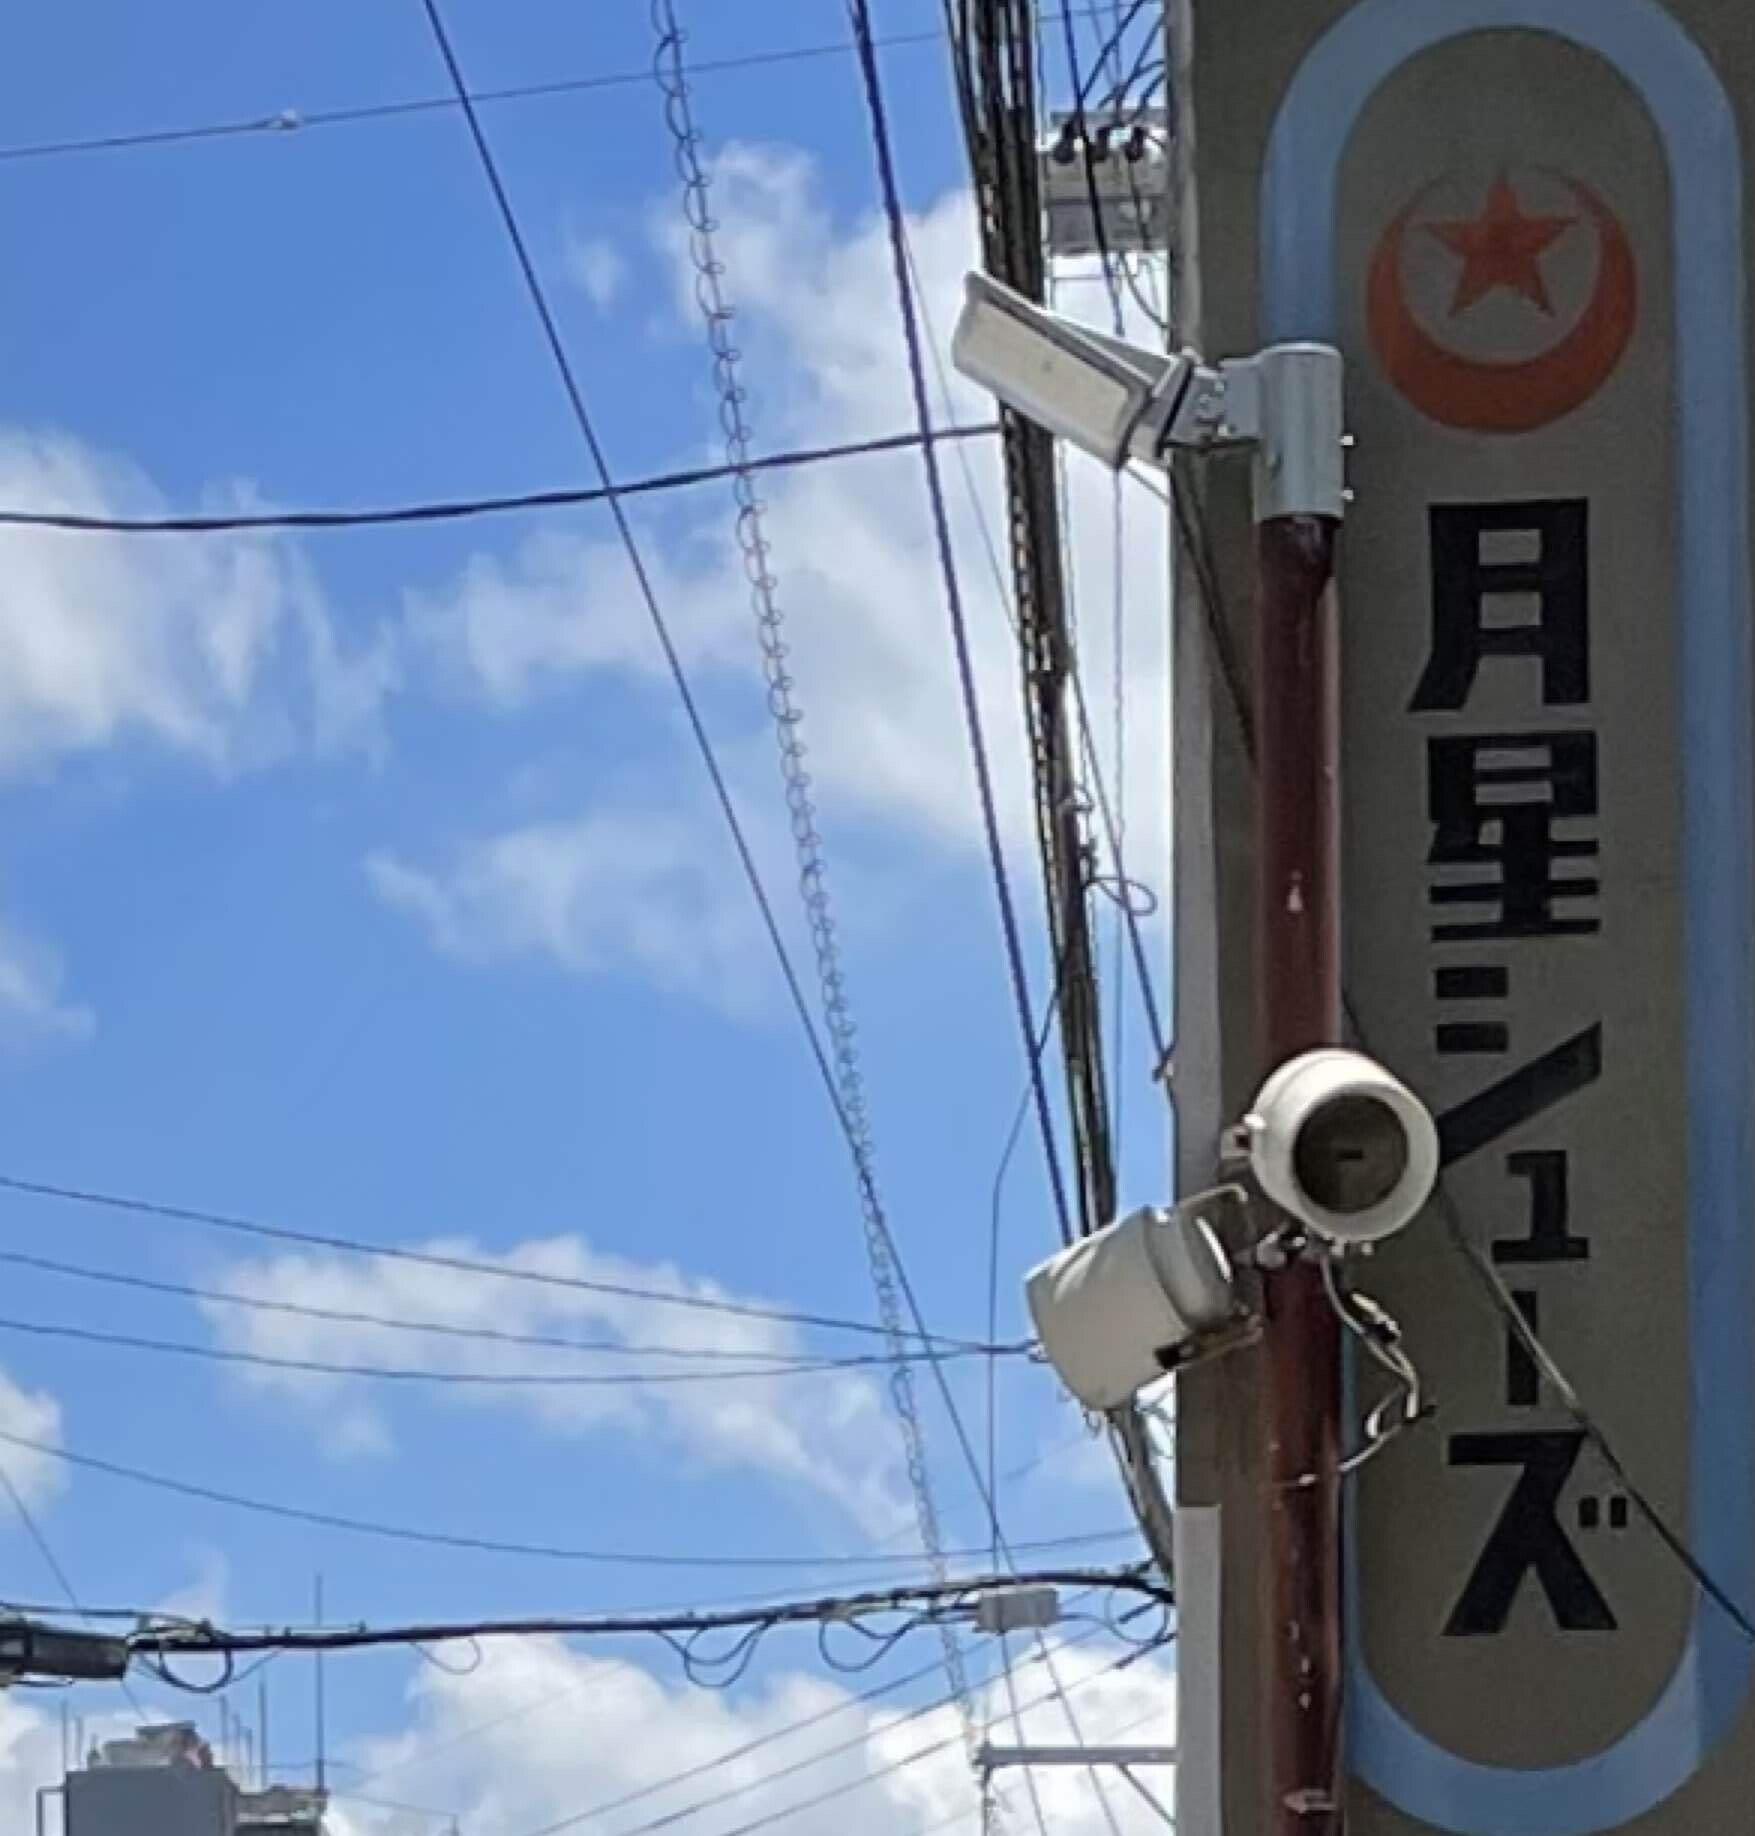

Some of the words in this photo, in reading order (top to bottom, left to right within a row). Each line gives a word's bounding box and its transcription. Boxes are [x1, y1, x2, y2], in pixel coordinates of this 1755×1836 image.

[1407, 497, 1627, 1636] 月星シューズ
